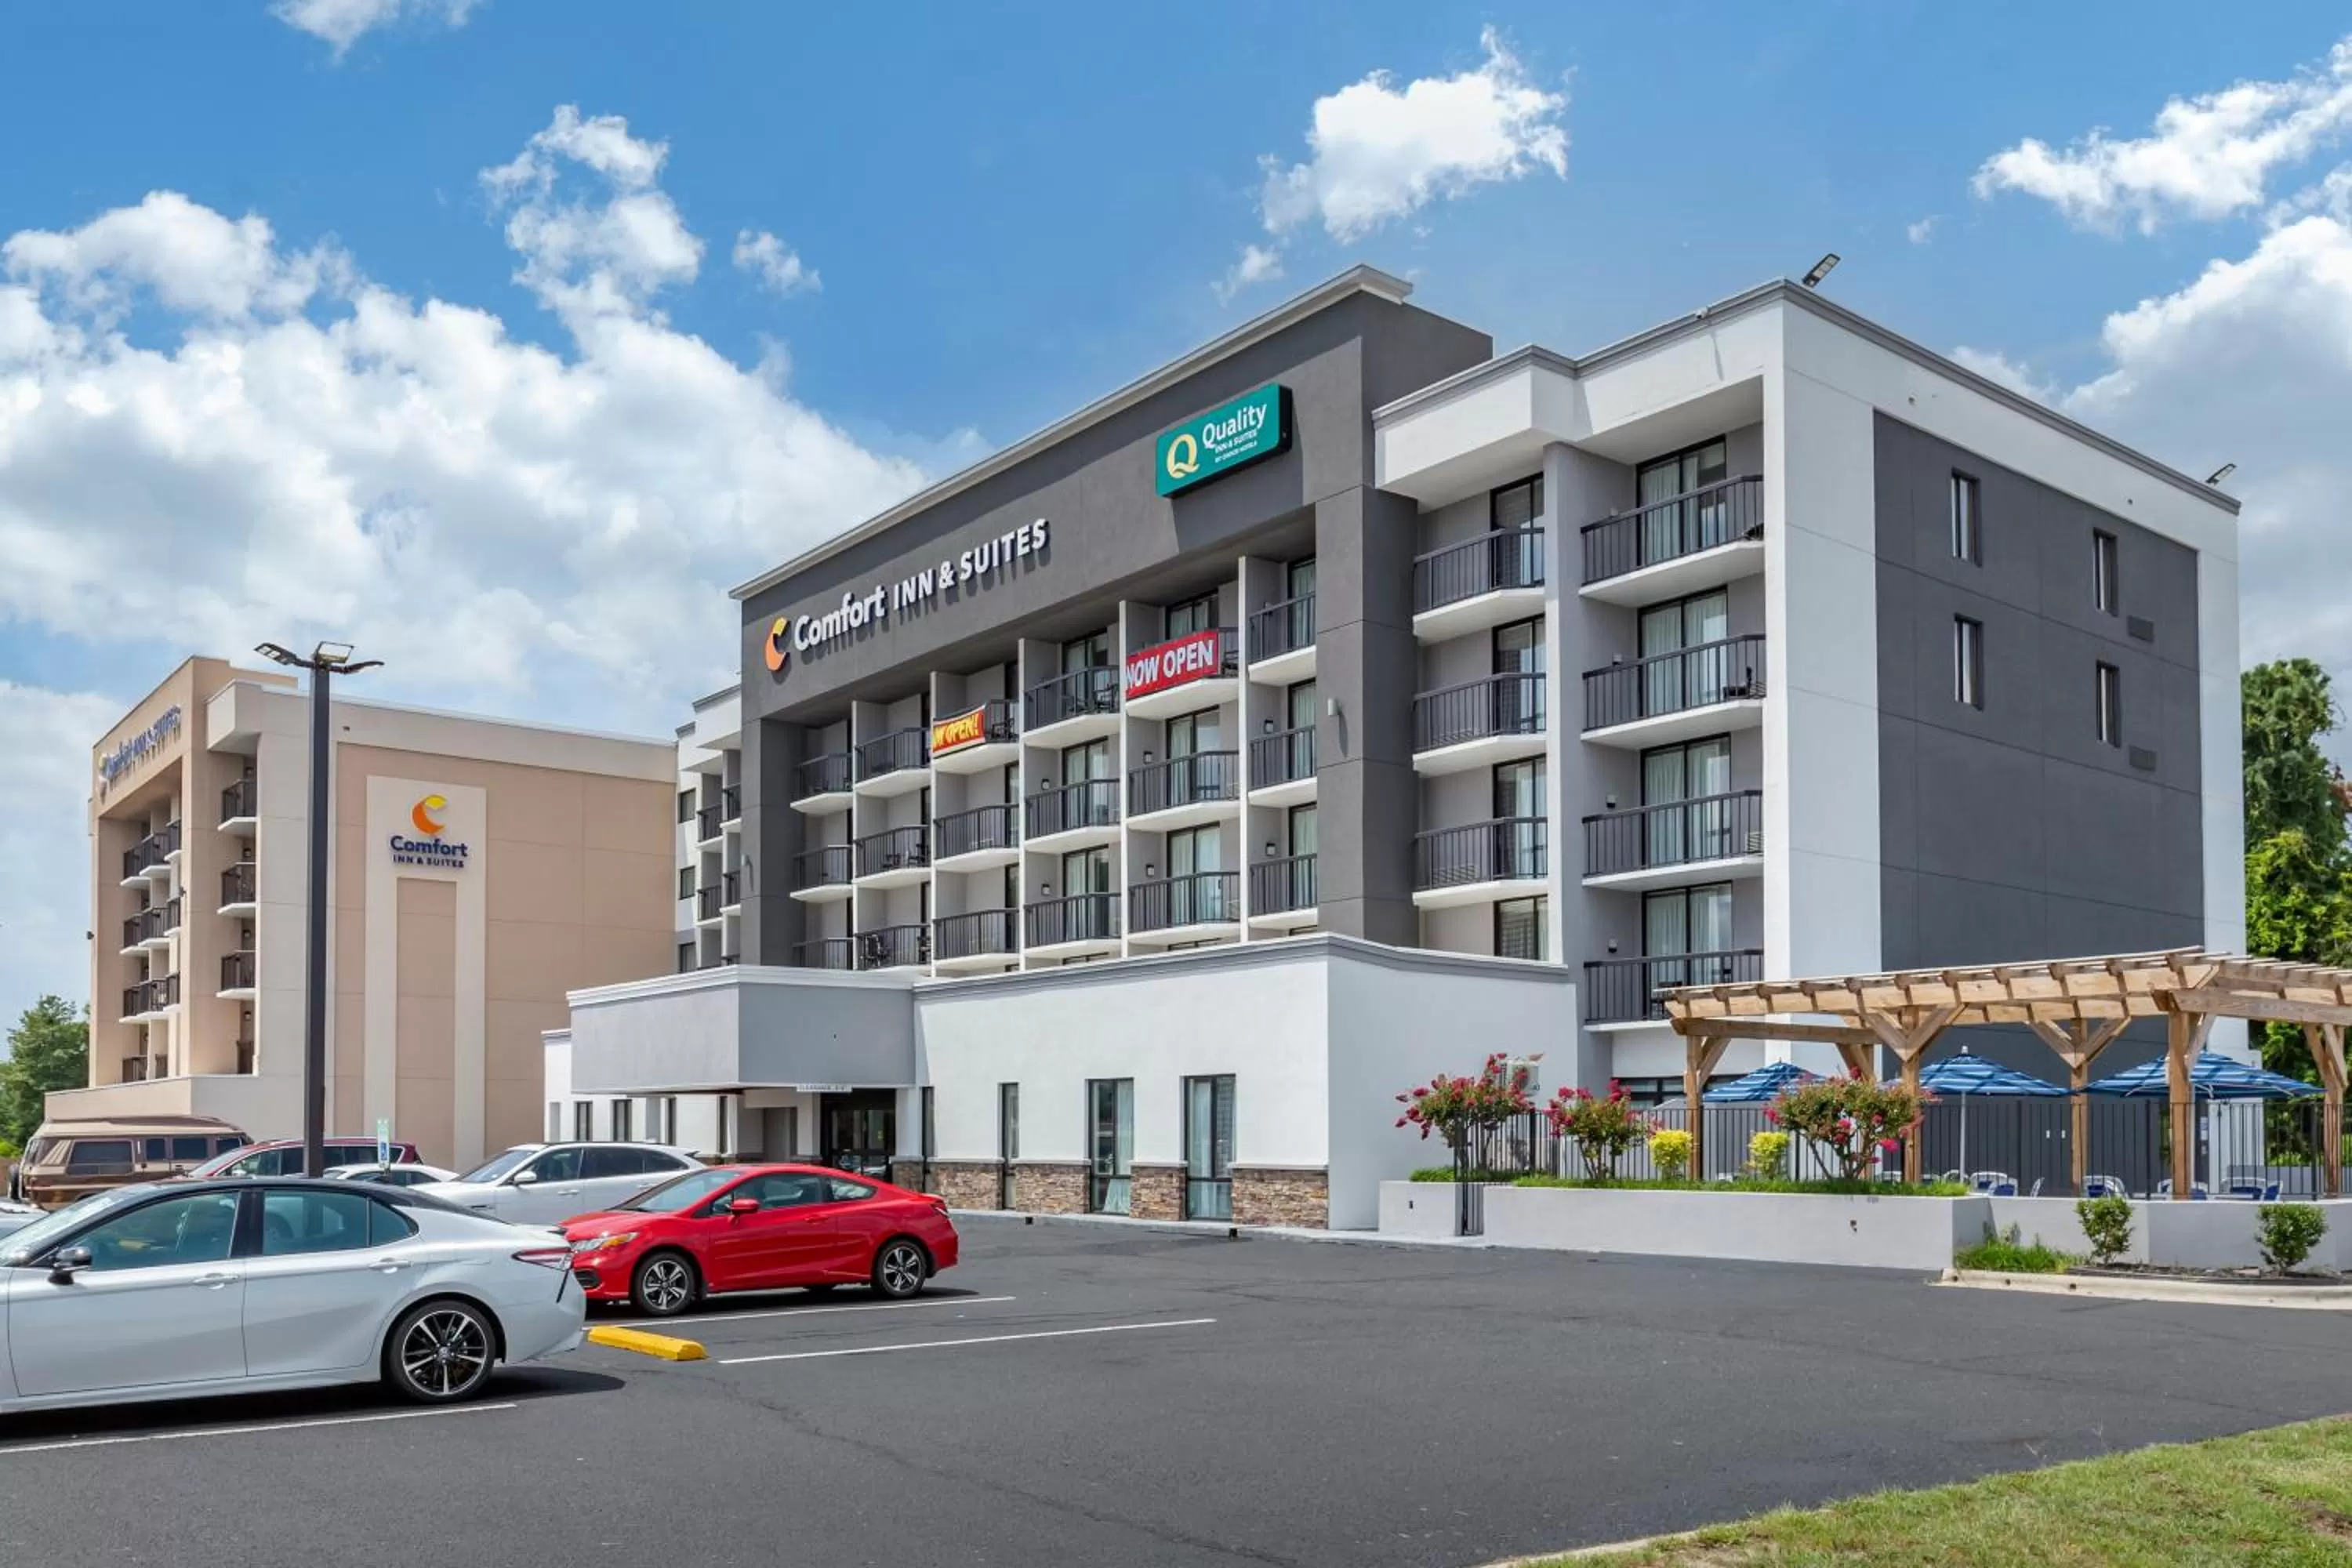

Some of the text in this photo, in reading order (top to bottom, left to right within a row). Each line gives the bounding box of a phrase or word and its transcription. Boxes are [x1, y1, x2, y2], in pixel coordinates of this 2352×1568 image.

[1202, 404, 1268, 449] Quality
[1167, 434, 1200, 479] Q
[794, 517, 1049, 652] Comfort INN & SUITES
[1126, 639, 1214, 690] NOW OPEN
[946, 713, 979, 744] OPEN!
[390, 835, 468, 857] Comfort
[393, 854, 414, 864] INN
[426, 857, 465, 869] SUITES
